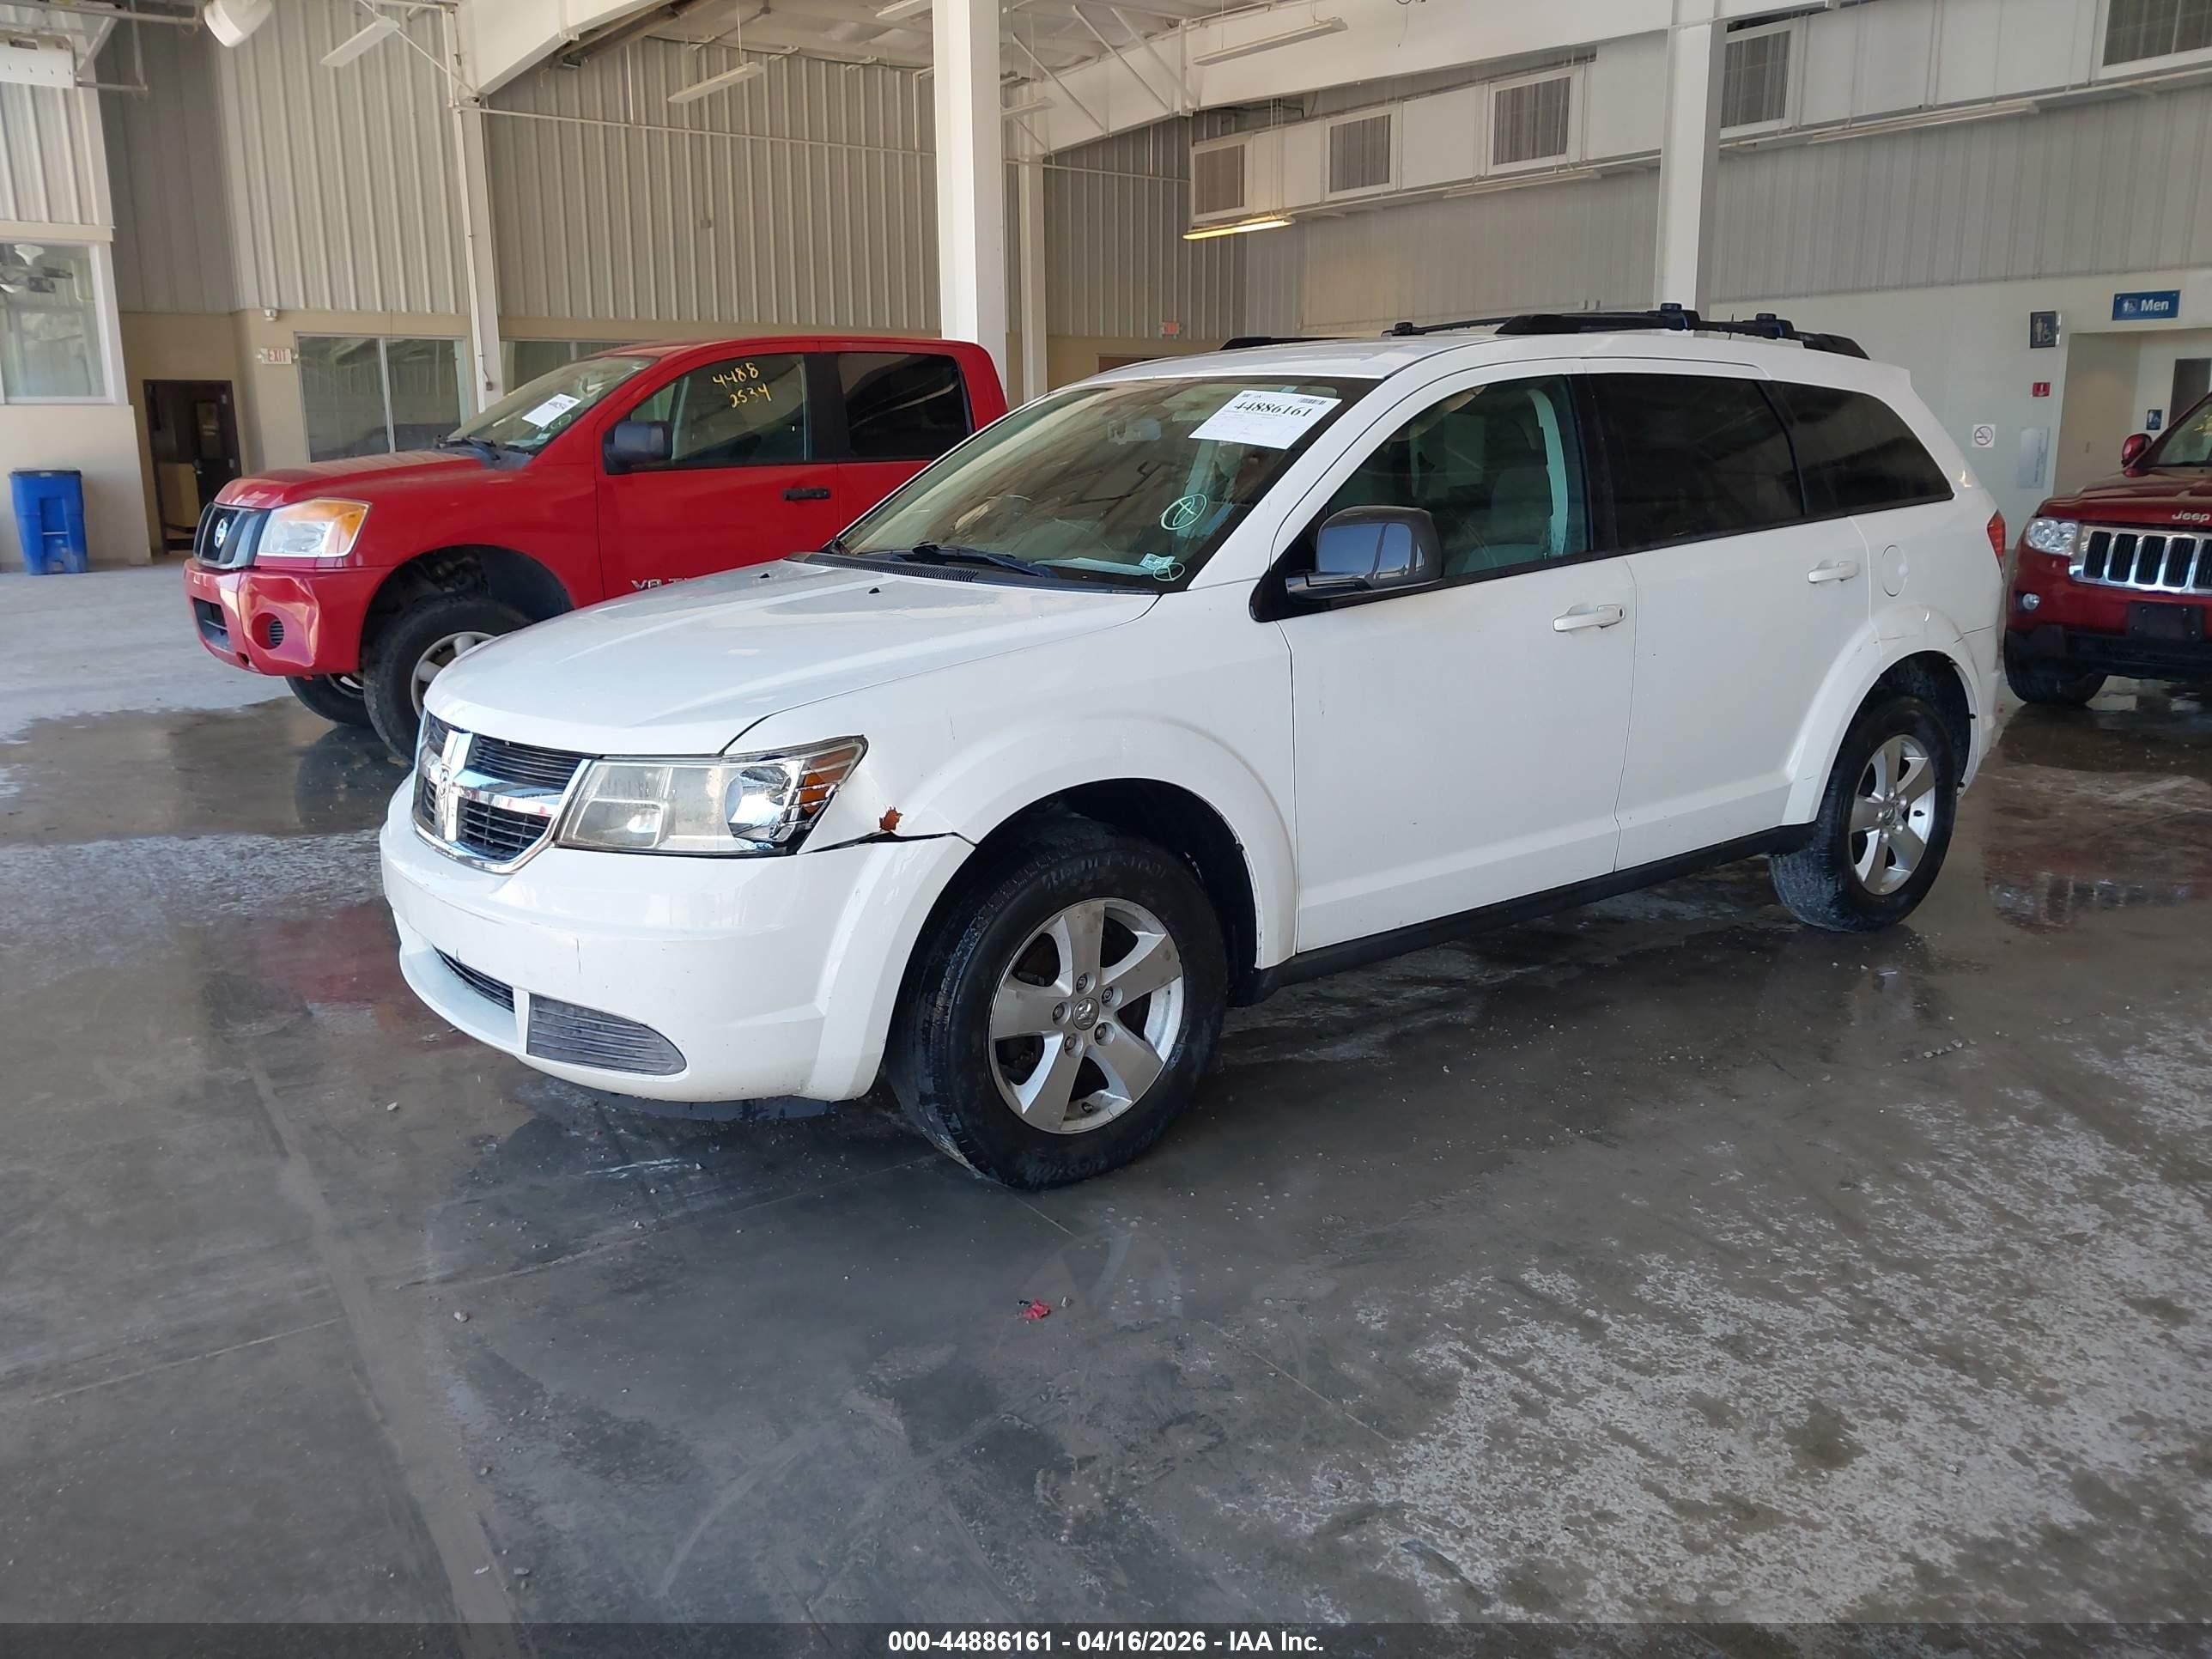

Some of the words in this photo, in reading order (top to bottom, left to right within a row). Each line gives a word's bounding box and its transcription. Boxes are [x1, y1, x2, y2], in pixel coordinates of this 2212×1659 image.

[2141, 299, 2169, 312] Men
[712, 362, 759, 389] 4488
[1234, 401, 1313, 417] 44886161
[2172, 510, 2211, 523] Jeep
